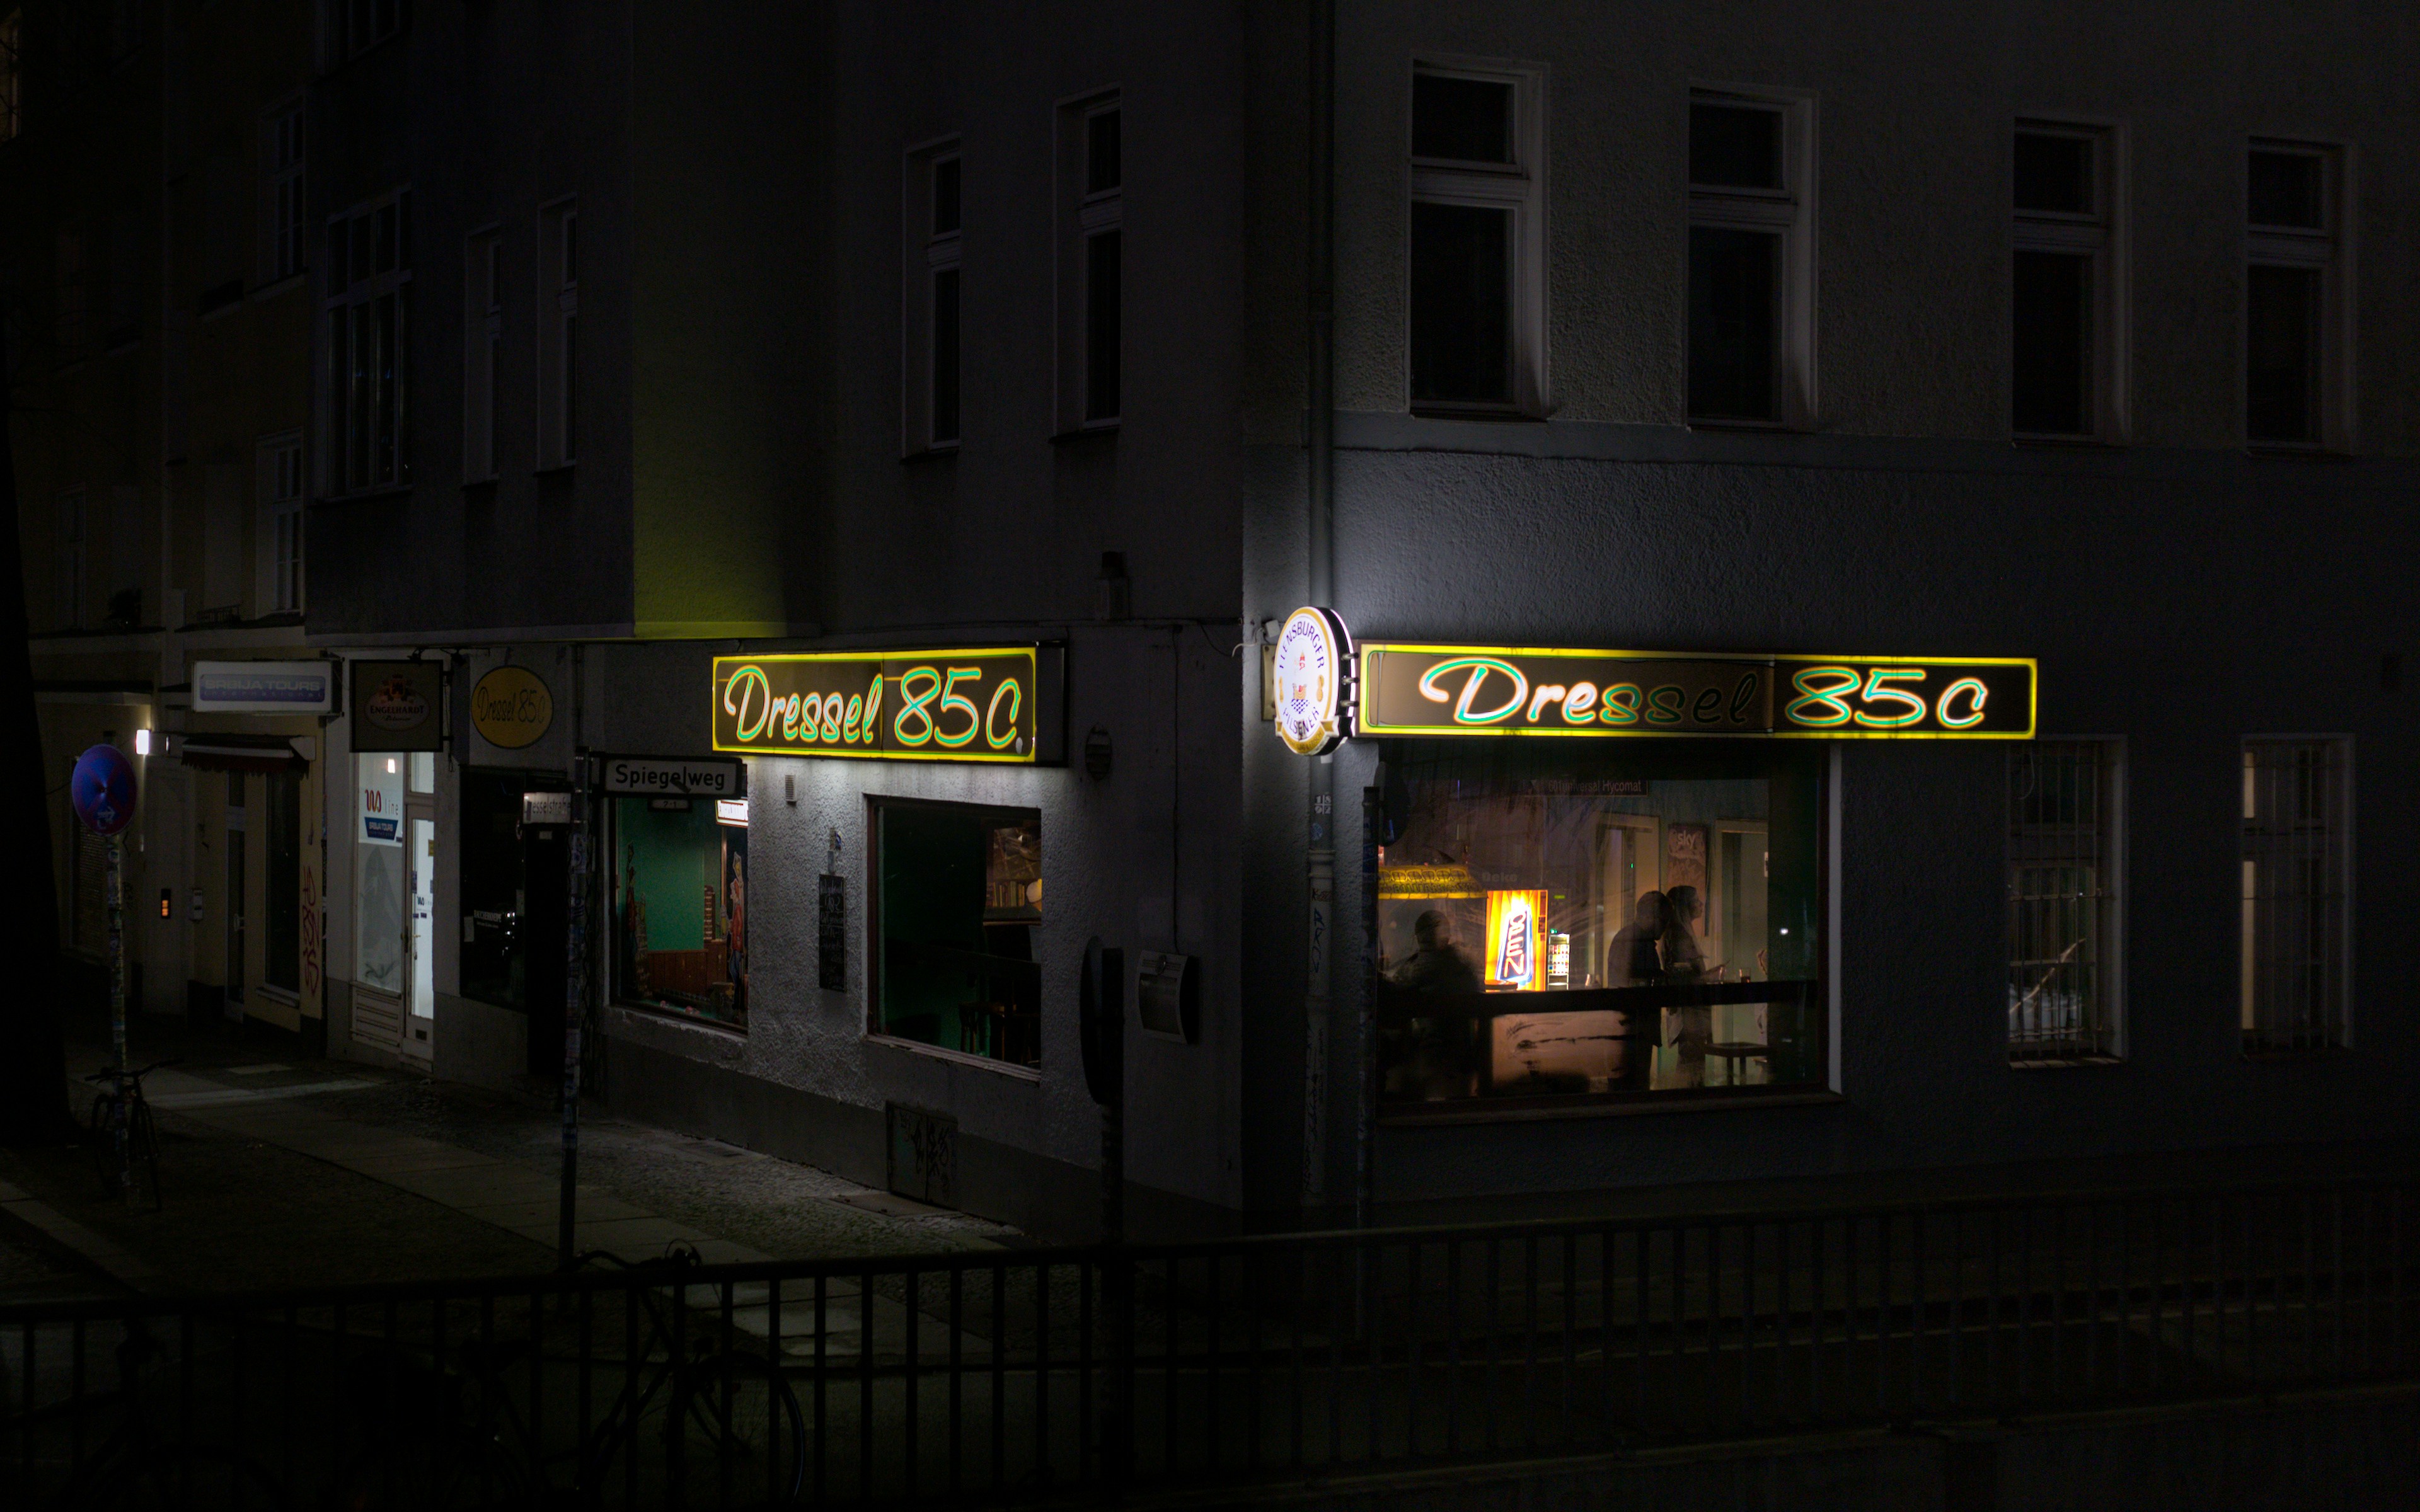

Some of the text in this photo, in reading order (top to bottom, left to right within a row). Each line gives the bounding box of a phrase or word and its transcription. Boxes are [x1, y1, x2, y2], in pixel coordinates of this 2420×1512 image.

[205, 679, 320, 692] SRBIJA TOURS
[1419, 658, 1758, 725] Dressel
[370, 705, 425, 714] ENGELHARDT
[477, 686, 516, 722] Dressel
[723, 664, 884, 744] Dressel
[615, 764, 725, 791] Spiegelweg
[1677, 830, 1697, 849] sky
[1503, 911, 1526, 978] OPEN
